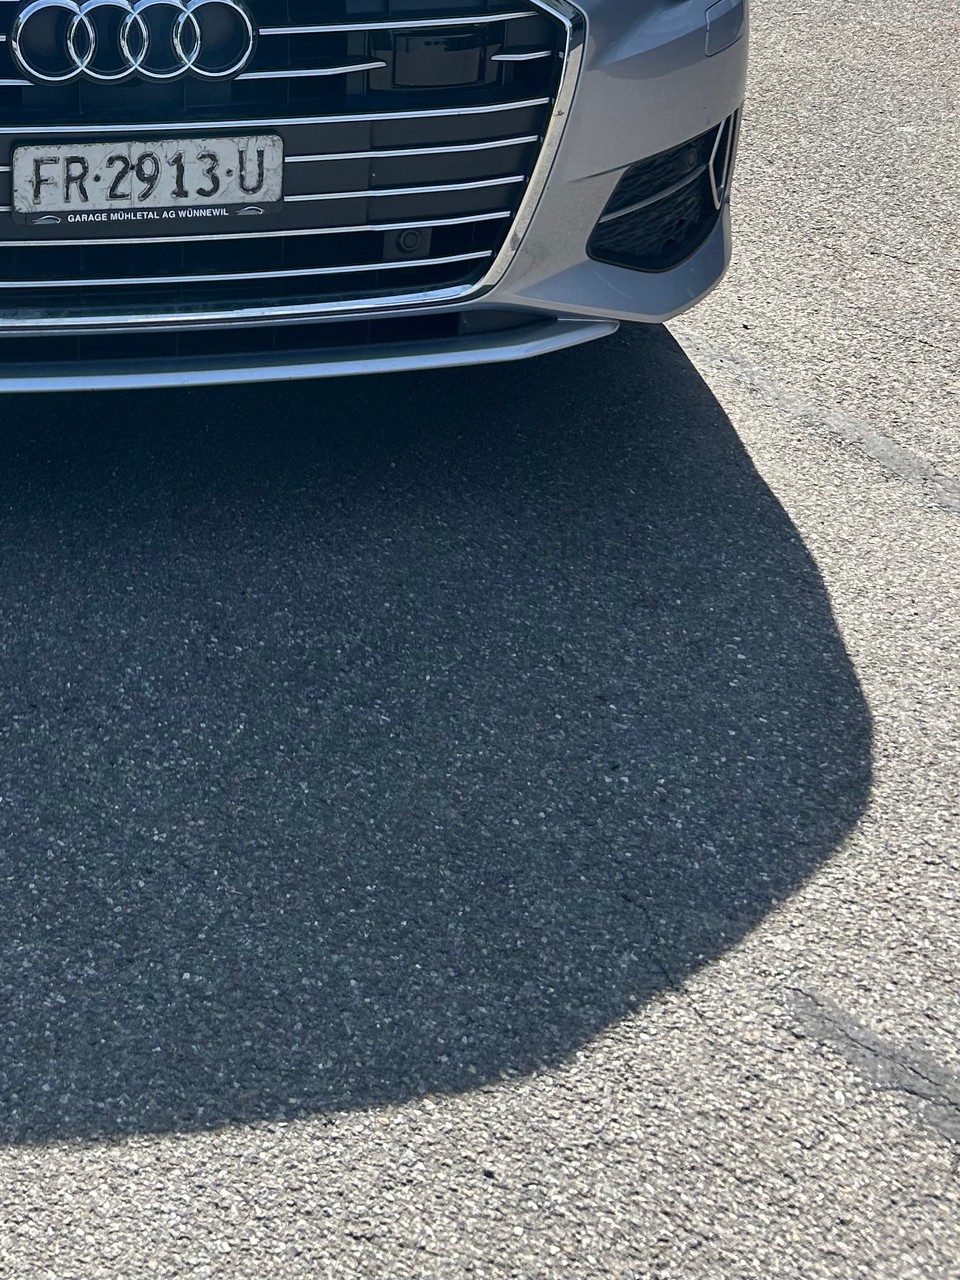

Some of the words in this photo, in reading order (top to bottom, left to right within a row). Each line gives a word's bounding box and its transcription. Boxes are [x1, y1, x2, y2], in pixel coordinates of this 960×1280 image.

[67, 213, 108, 223] GARAGE
[110, 209, 160, 221] MÜHLETAL
[162, 210, 176, 219] AG
[178, 207, 229, 219] WÜNNEWIL
